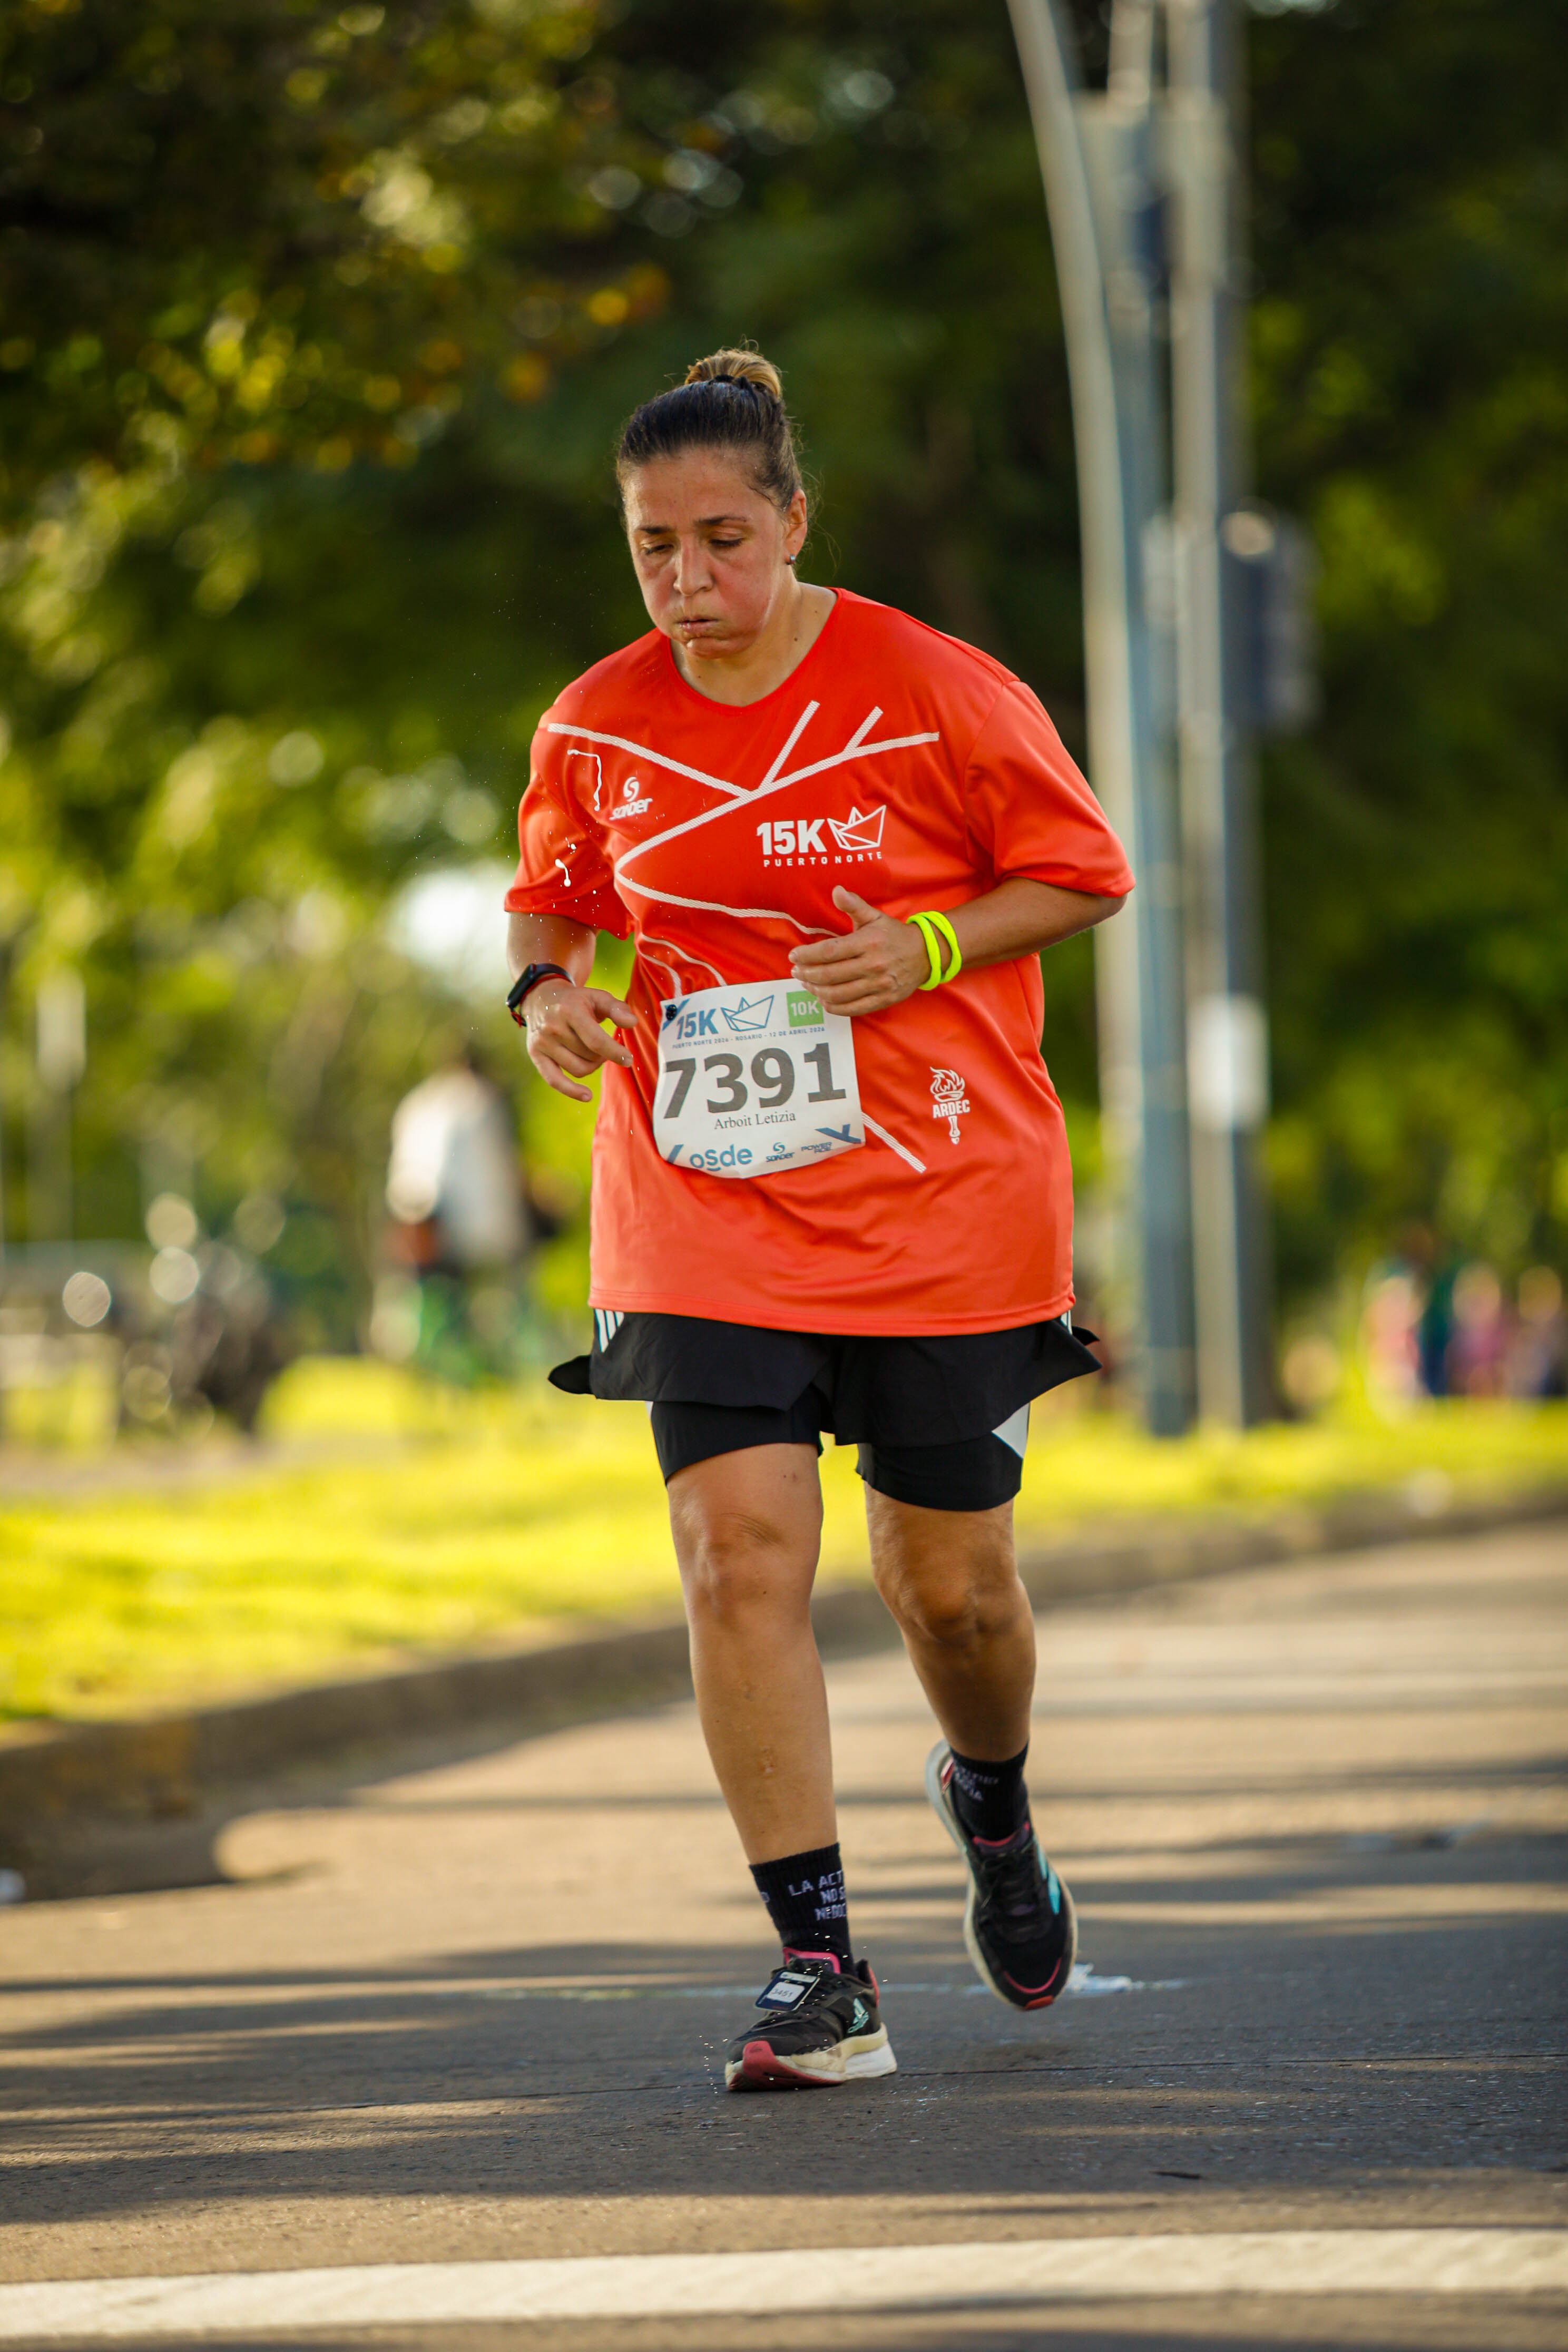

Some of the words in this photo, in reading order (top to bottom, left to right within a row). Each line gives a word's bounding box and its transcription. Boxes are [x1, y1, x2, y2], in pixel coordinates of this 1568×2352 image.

[756, 819, 827, 855] 15K
[763, 856, 828, 867] PUERTO
[835, 851, 882, 864] NORTE
[790, 1001, 819, 1016] 10K
[676, 1008, 719, 1040] 15K
[663, 1042, 847, 1119] 7391
[932, 1099, 971, 1119] ARDEC
[714, 1114, 752, 1130] Arboit
[755, 1111, 797, 1125] Letizia
[690, 1144, 753, 1169] osde
[789, 1879, 814, 1896] LA
[820, 1888, 838, 1905] NO
